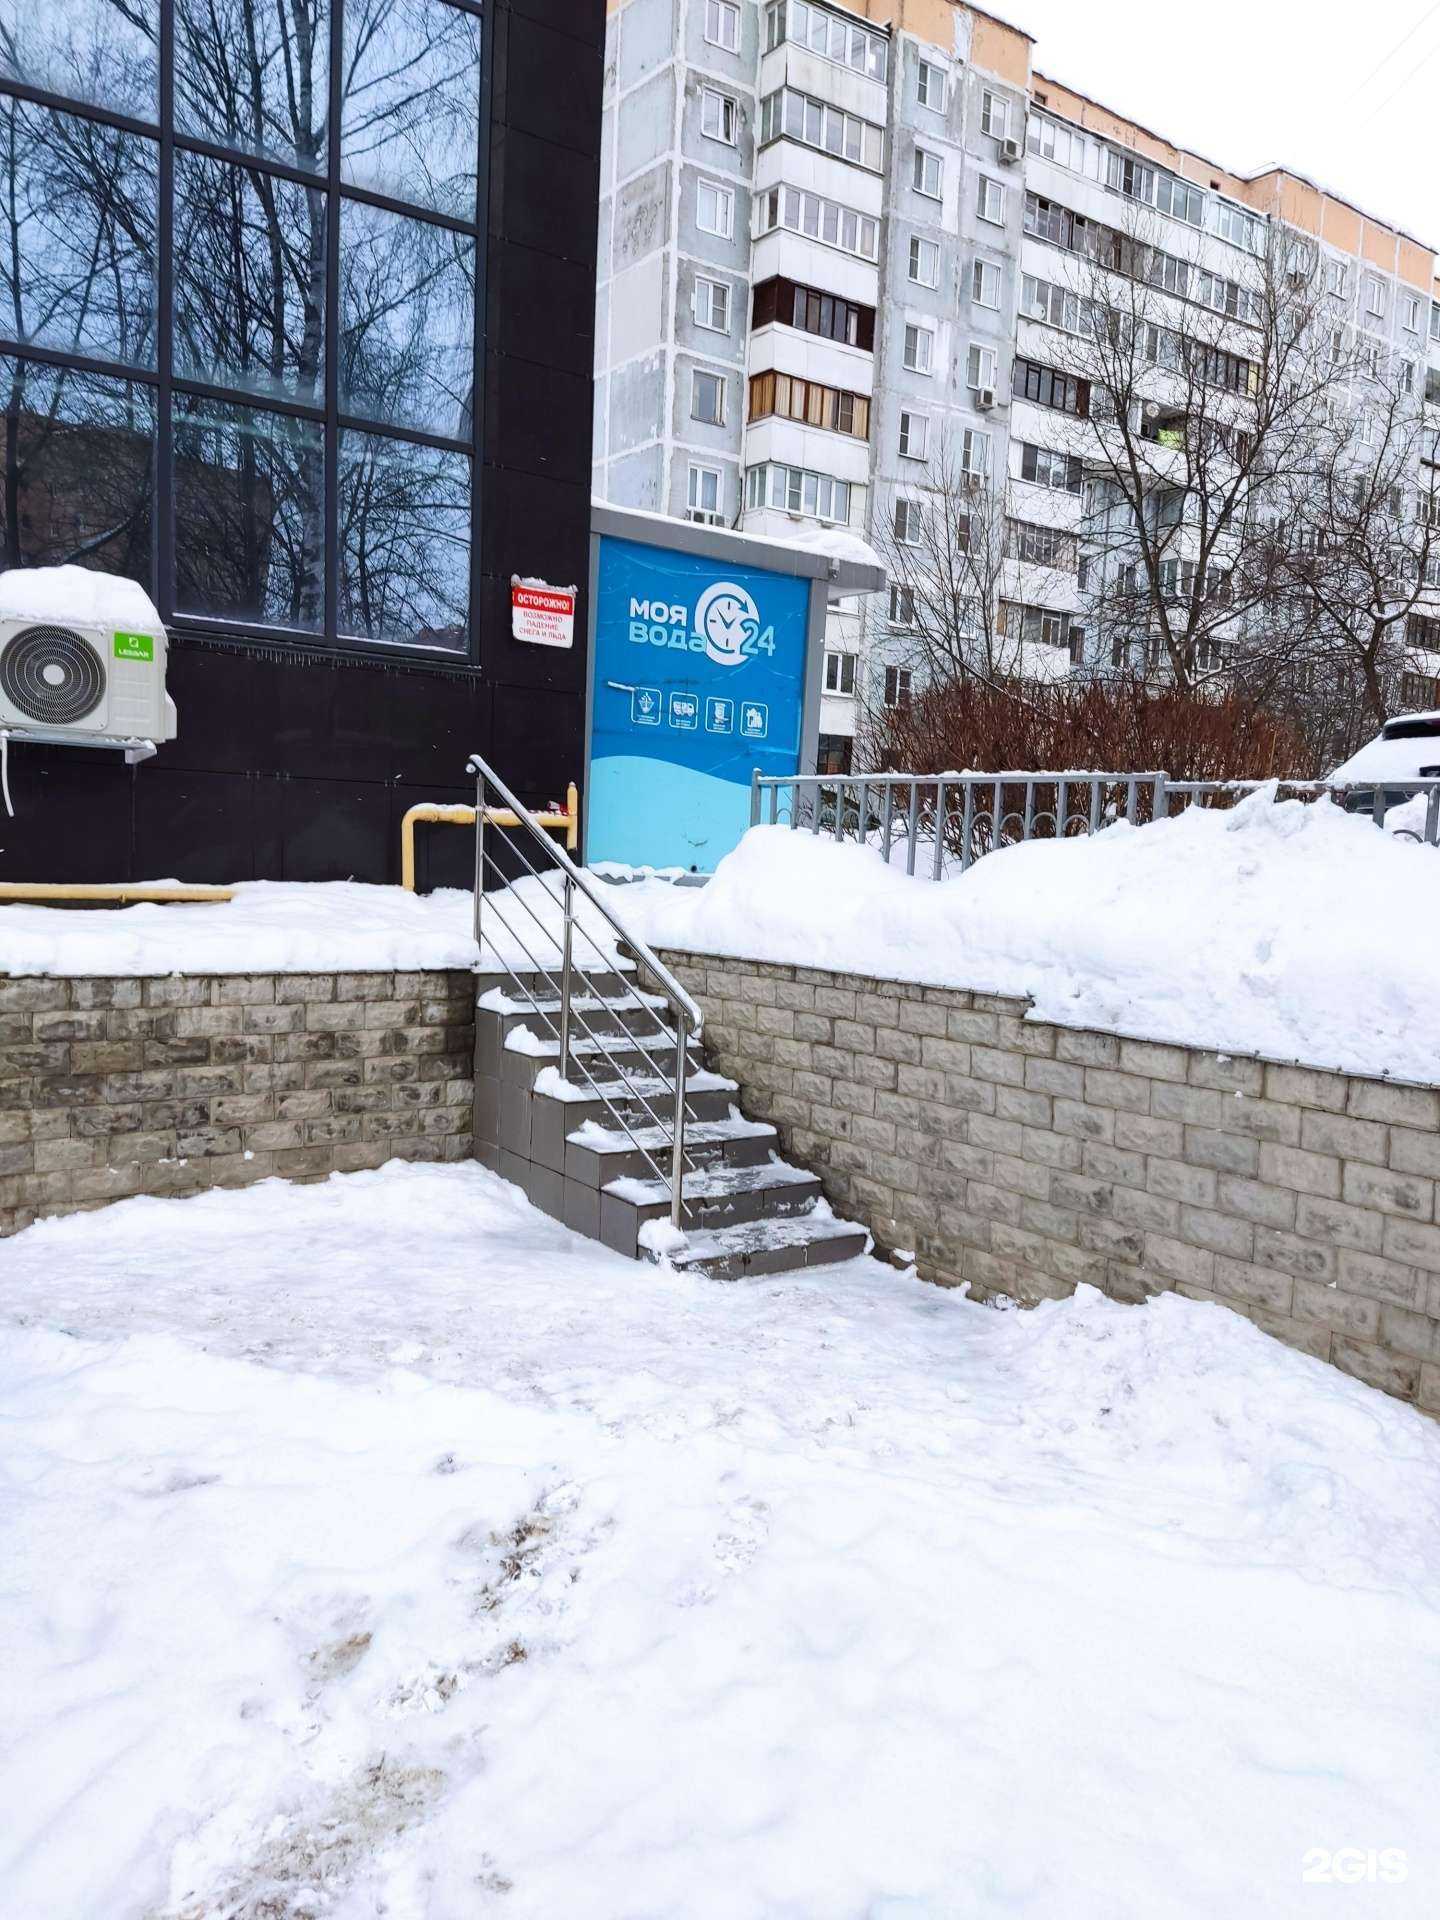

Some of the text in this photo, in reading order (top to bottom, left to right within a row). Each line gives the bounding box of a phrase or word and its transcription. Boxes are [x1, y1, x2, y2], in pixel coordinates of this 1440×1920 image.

[517, 593, 570, 611] ОСТОРОЖНО!
[523, 611, 563, 623] ВОЗМОЖНО
[629, 597, 688, 627] МОЯ
[527, 620, 559, 630] ПАДЕНИЕ
[518, 627, 540, 637] СНЕГА
[548, 632, 567, 641] ЛЬДА
[740, 620, 776, 657] 24
